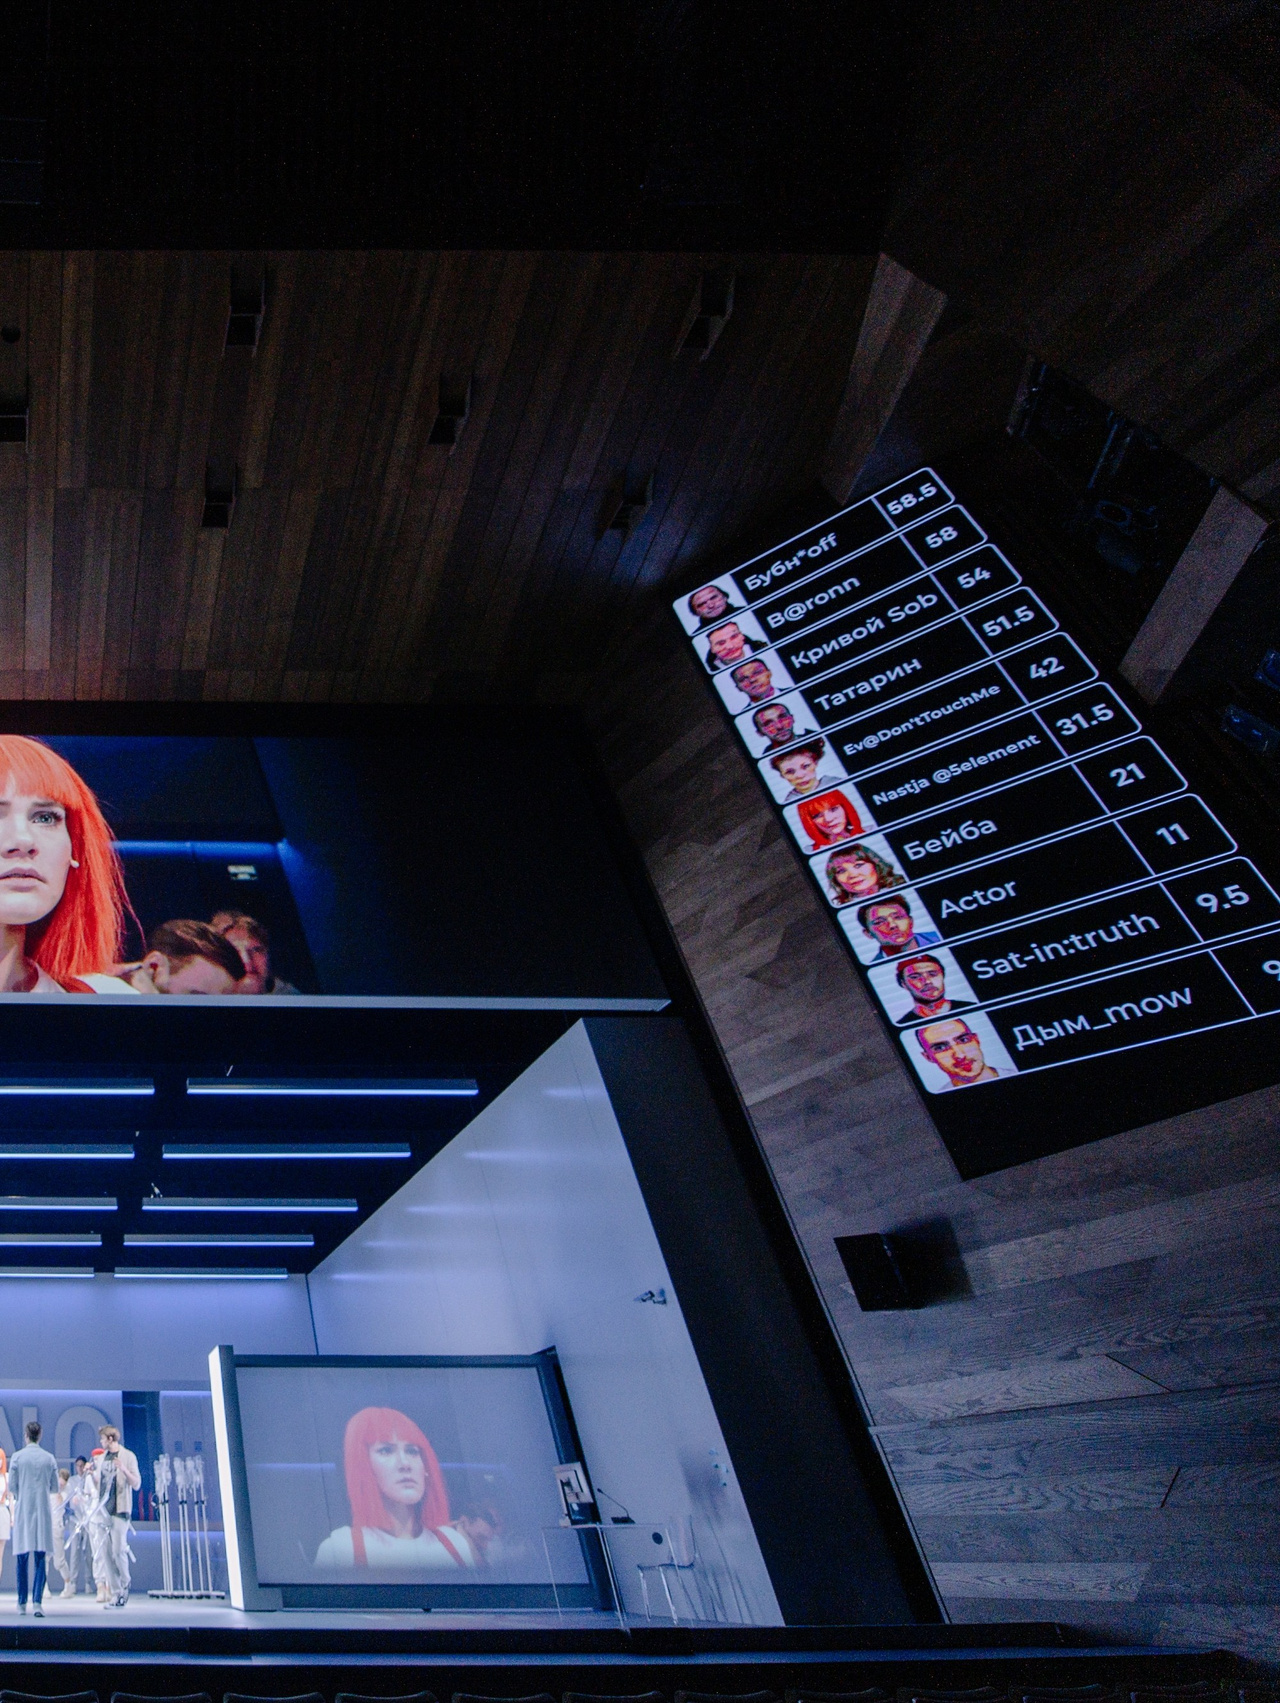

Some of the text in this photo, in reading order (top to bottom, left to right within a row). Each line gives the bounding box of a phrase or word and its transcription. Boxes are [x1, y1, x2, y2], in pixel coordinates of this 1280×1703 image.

[886, 482, 937, 515] 58.5
[766, 526, 958, 629] B@ronn 58
[790, 567, 991, 669] Кривой Sob 54
[813, 605, 1035, 711] Татарин 51.5
[1030, 657, 1065, 679] 42
[872, 703, 1114, 806] Nastja @5element 31.5
[903, 762, 1146, 861] Бейба 21
[941, 823, 1190, 919] Actor 11
[972, 884, 1250, 979] Sat-in:truth 9.5
[1012, 987, 1192, 1051] Дым_mow
